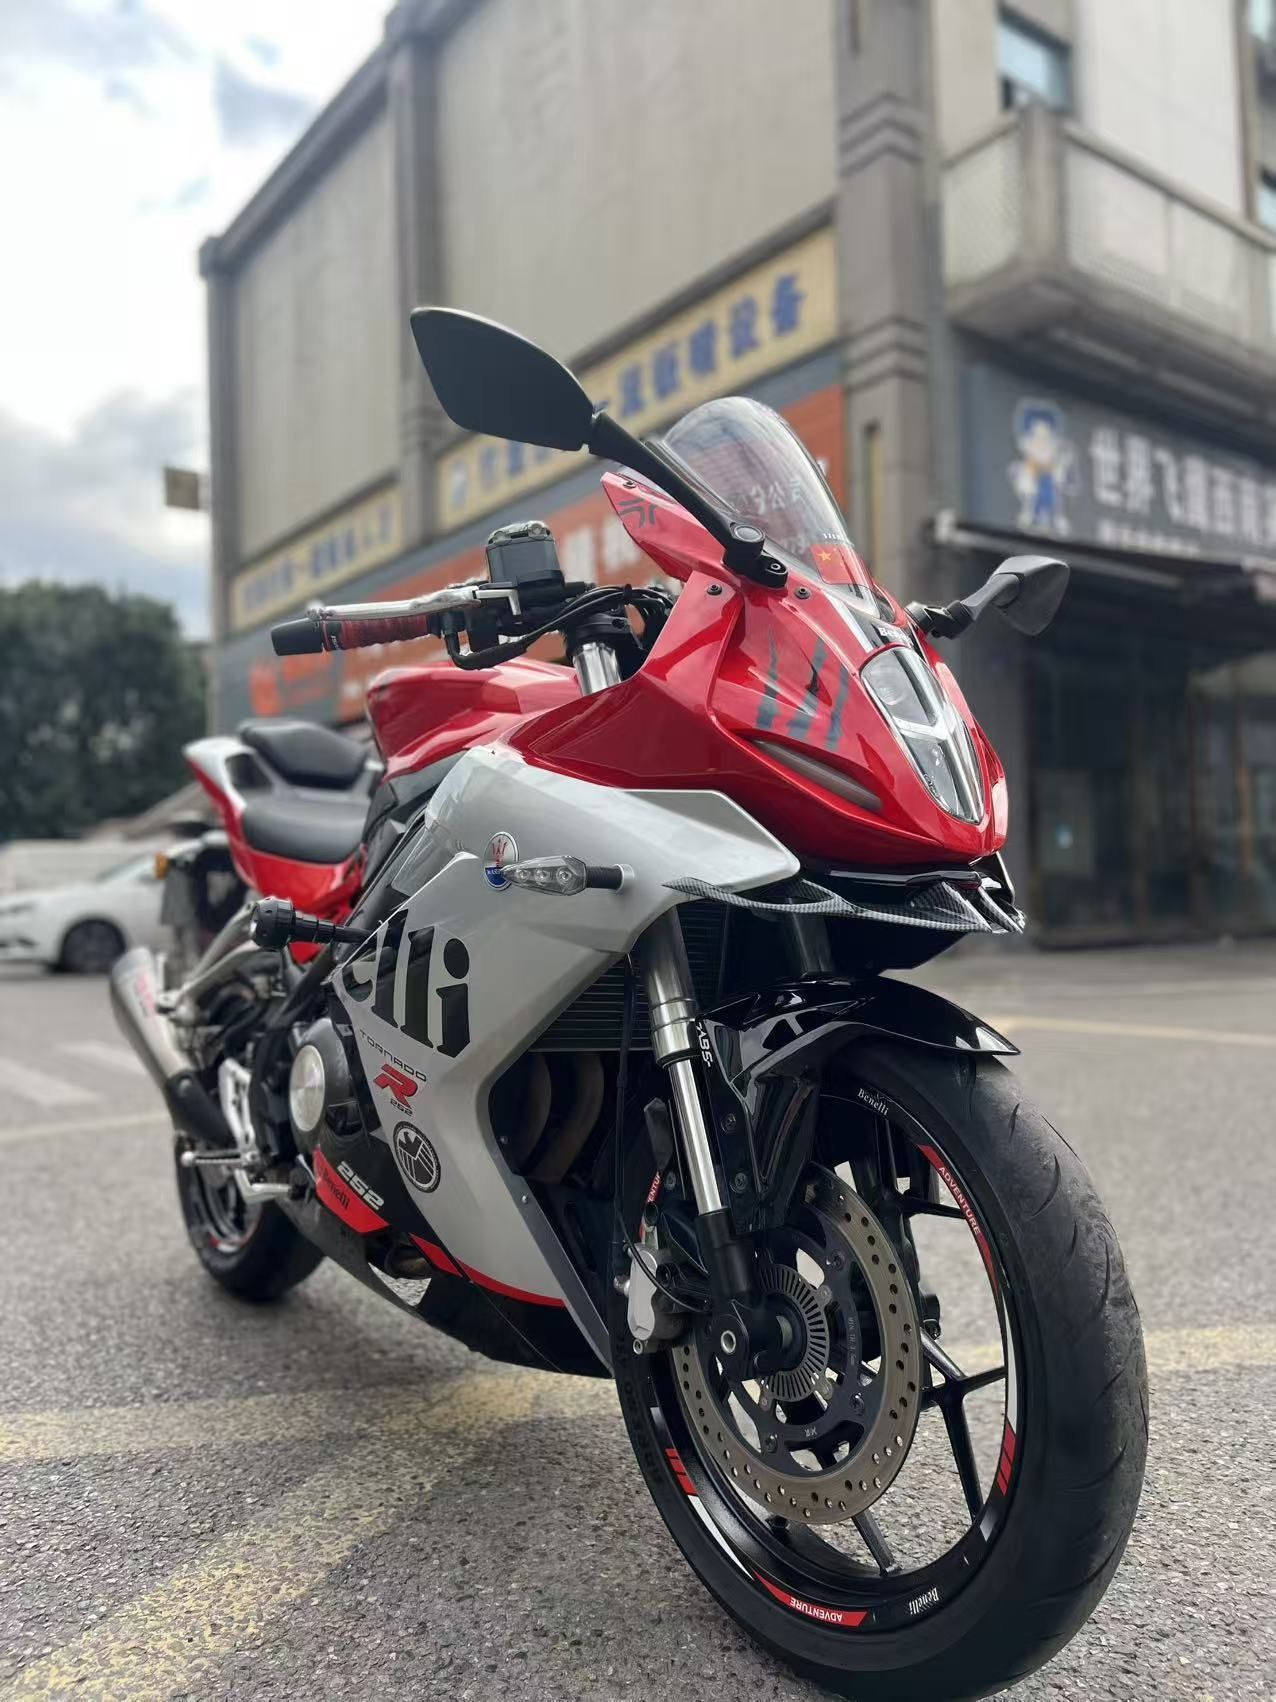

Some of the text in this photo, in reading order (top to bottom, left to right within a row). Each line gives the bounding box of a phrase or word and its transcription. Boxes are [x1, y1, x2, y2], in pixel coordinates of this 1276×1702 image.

[360, 1029, 427, 1082] TORNADO
[373, 1063, 418, 1110] R
[857, 1087, 889, 1117] Benelli
[390, 1098, 413, 1117] 252
[337, 1161, 385, 1211] 252
[938, 1166, 982, 1236] ADVENTURE
[789, 1596, 843, 1623] ADVENTURE
[908, 1587, 940, 1616] Benelli
